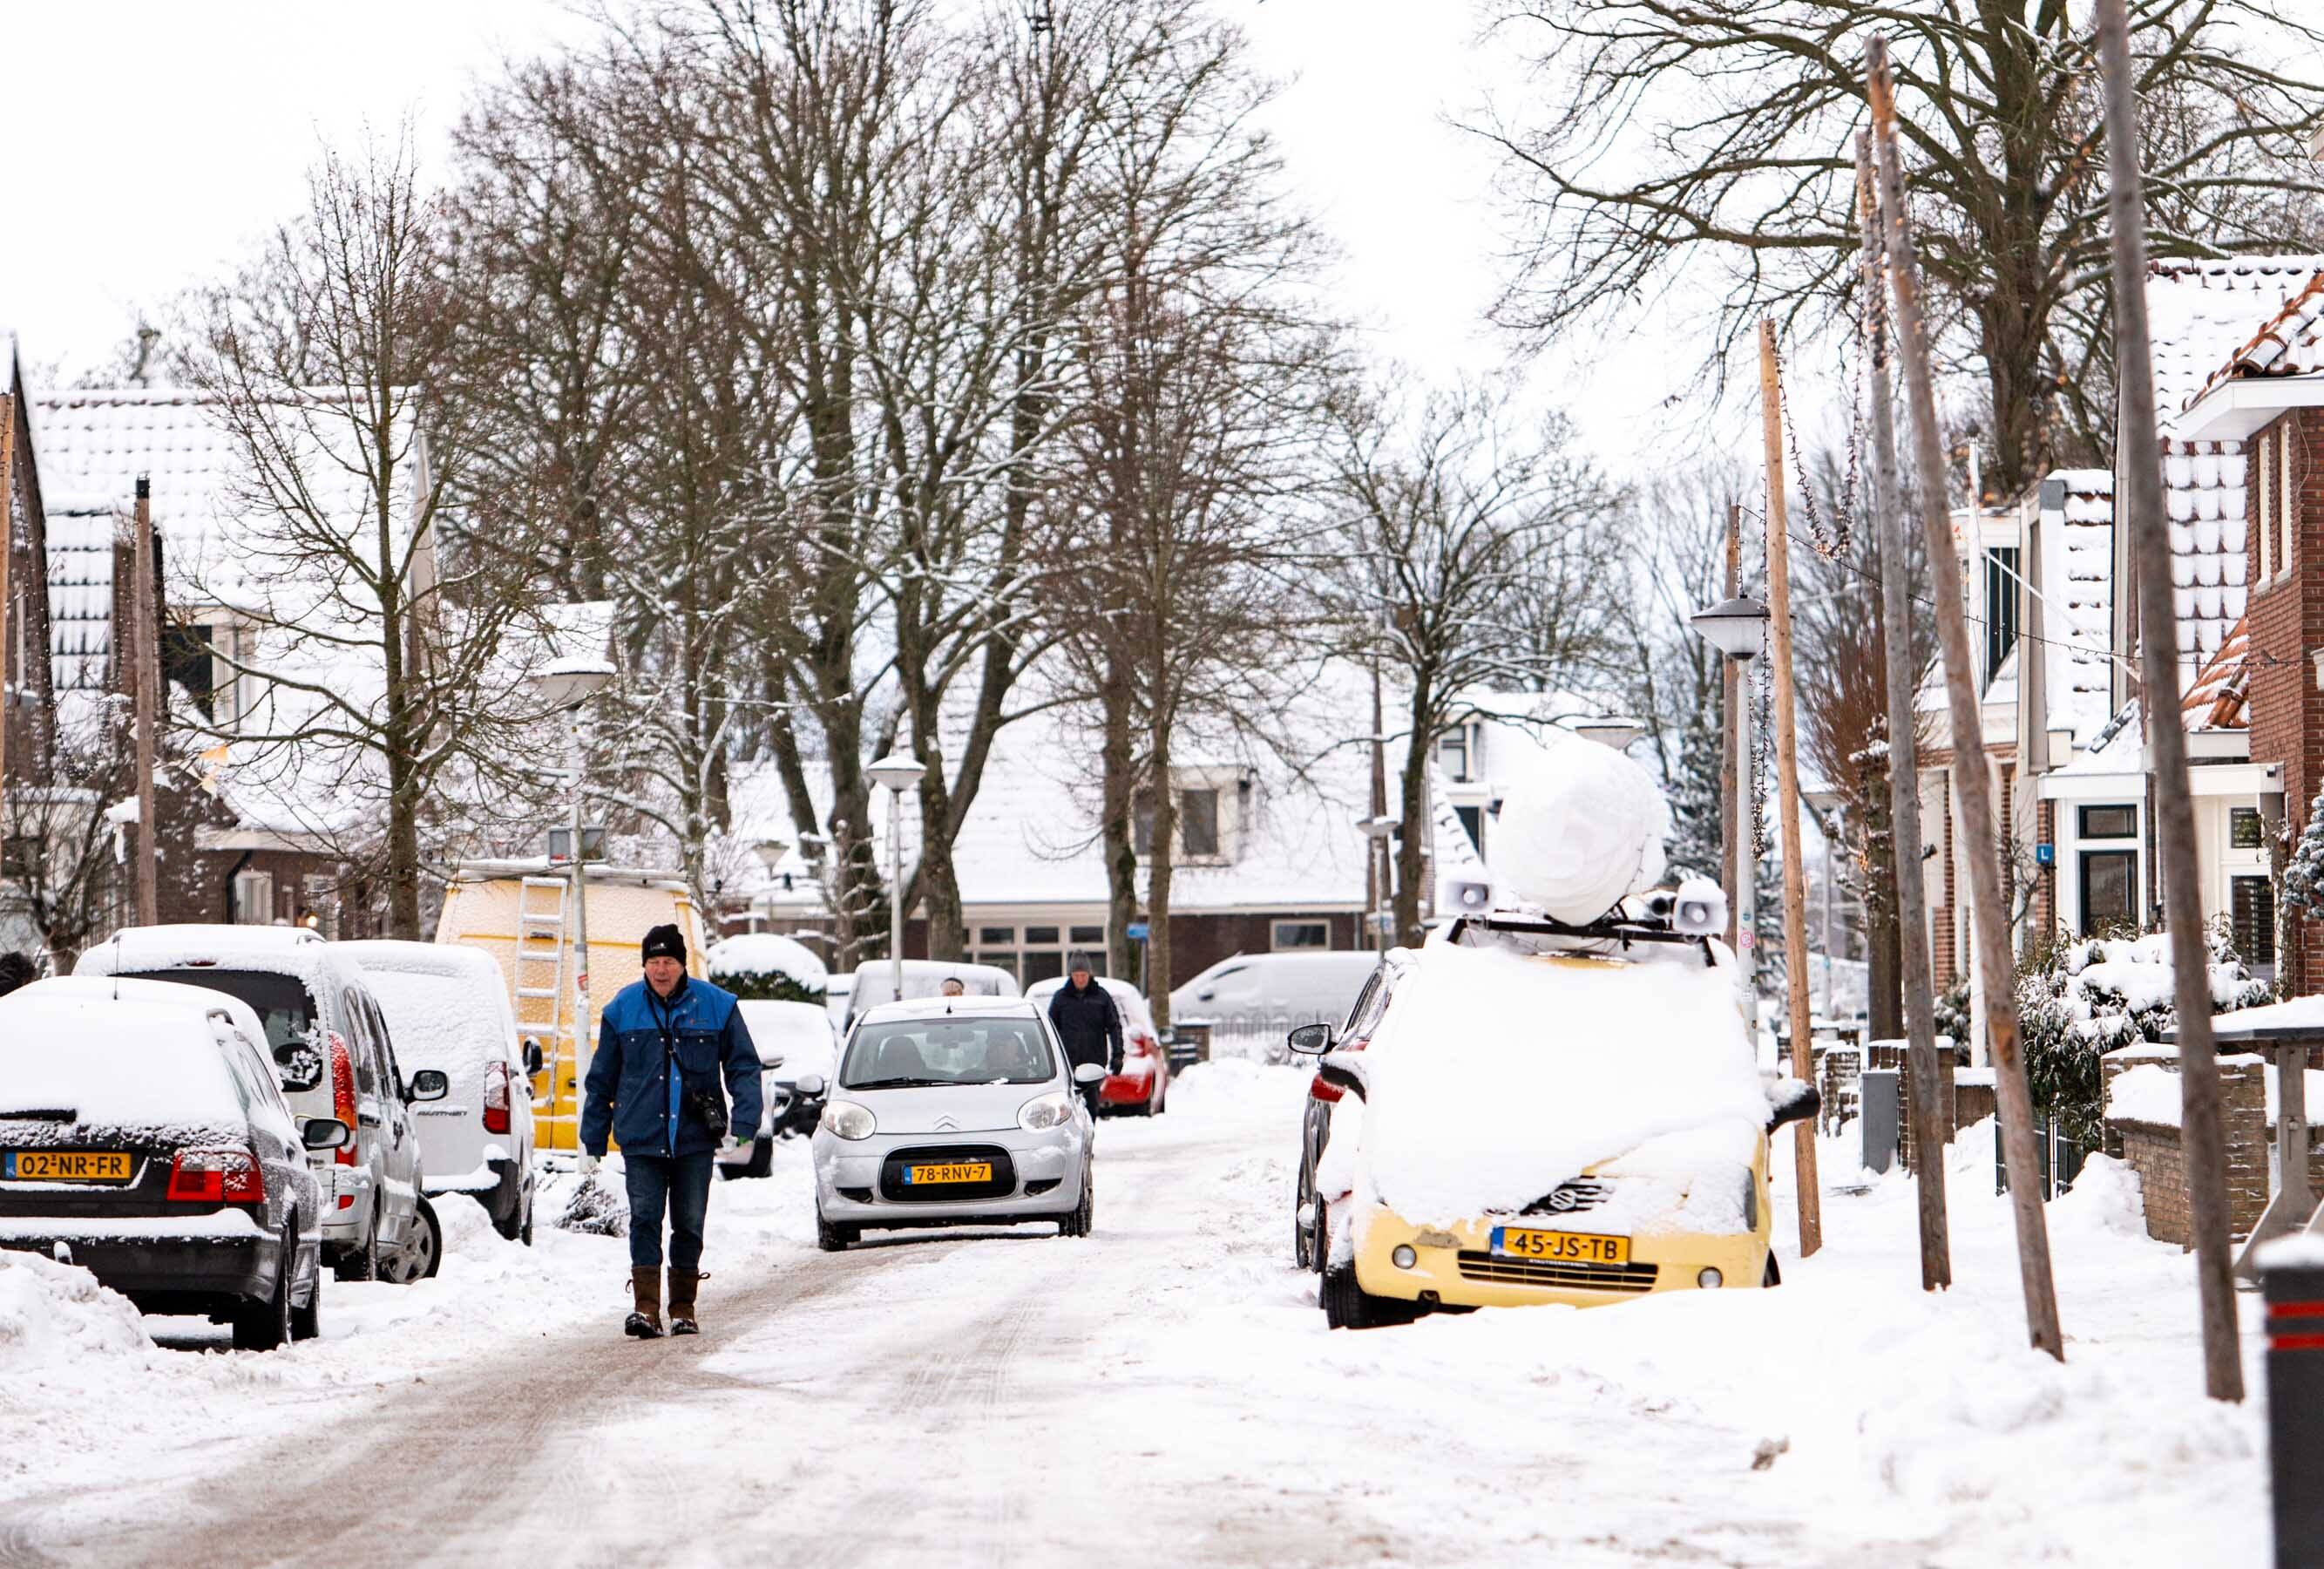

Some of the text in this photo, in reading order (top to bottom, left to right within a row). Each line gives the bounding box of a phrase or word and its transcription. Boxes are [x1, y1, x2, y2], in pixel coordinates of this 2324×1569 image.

[2041, 847, 2049, 859] L
[917, 1165, 986, 1182] 78-RNV-7
[1514, 1233, 1618, 1260] 45-JS-TB
